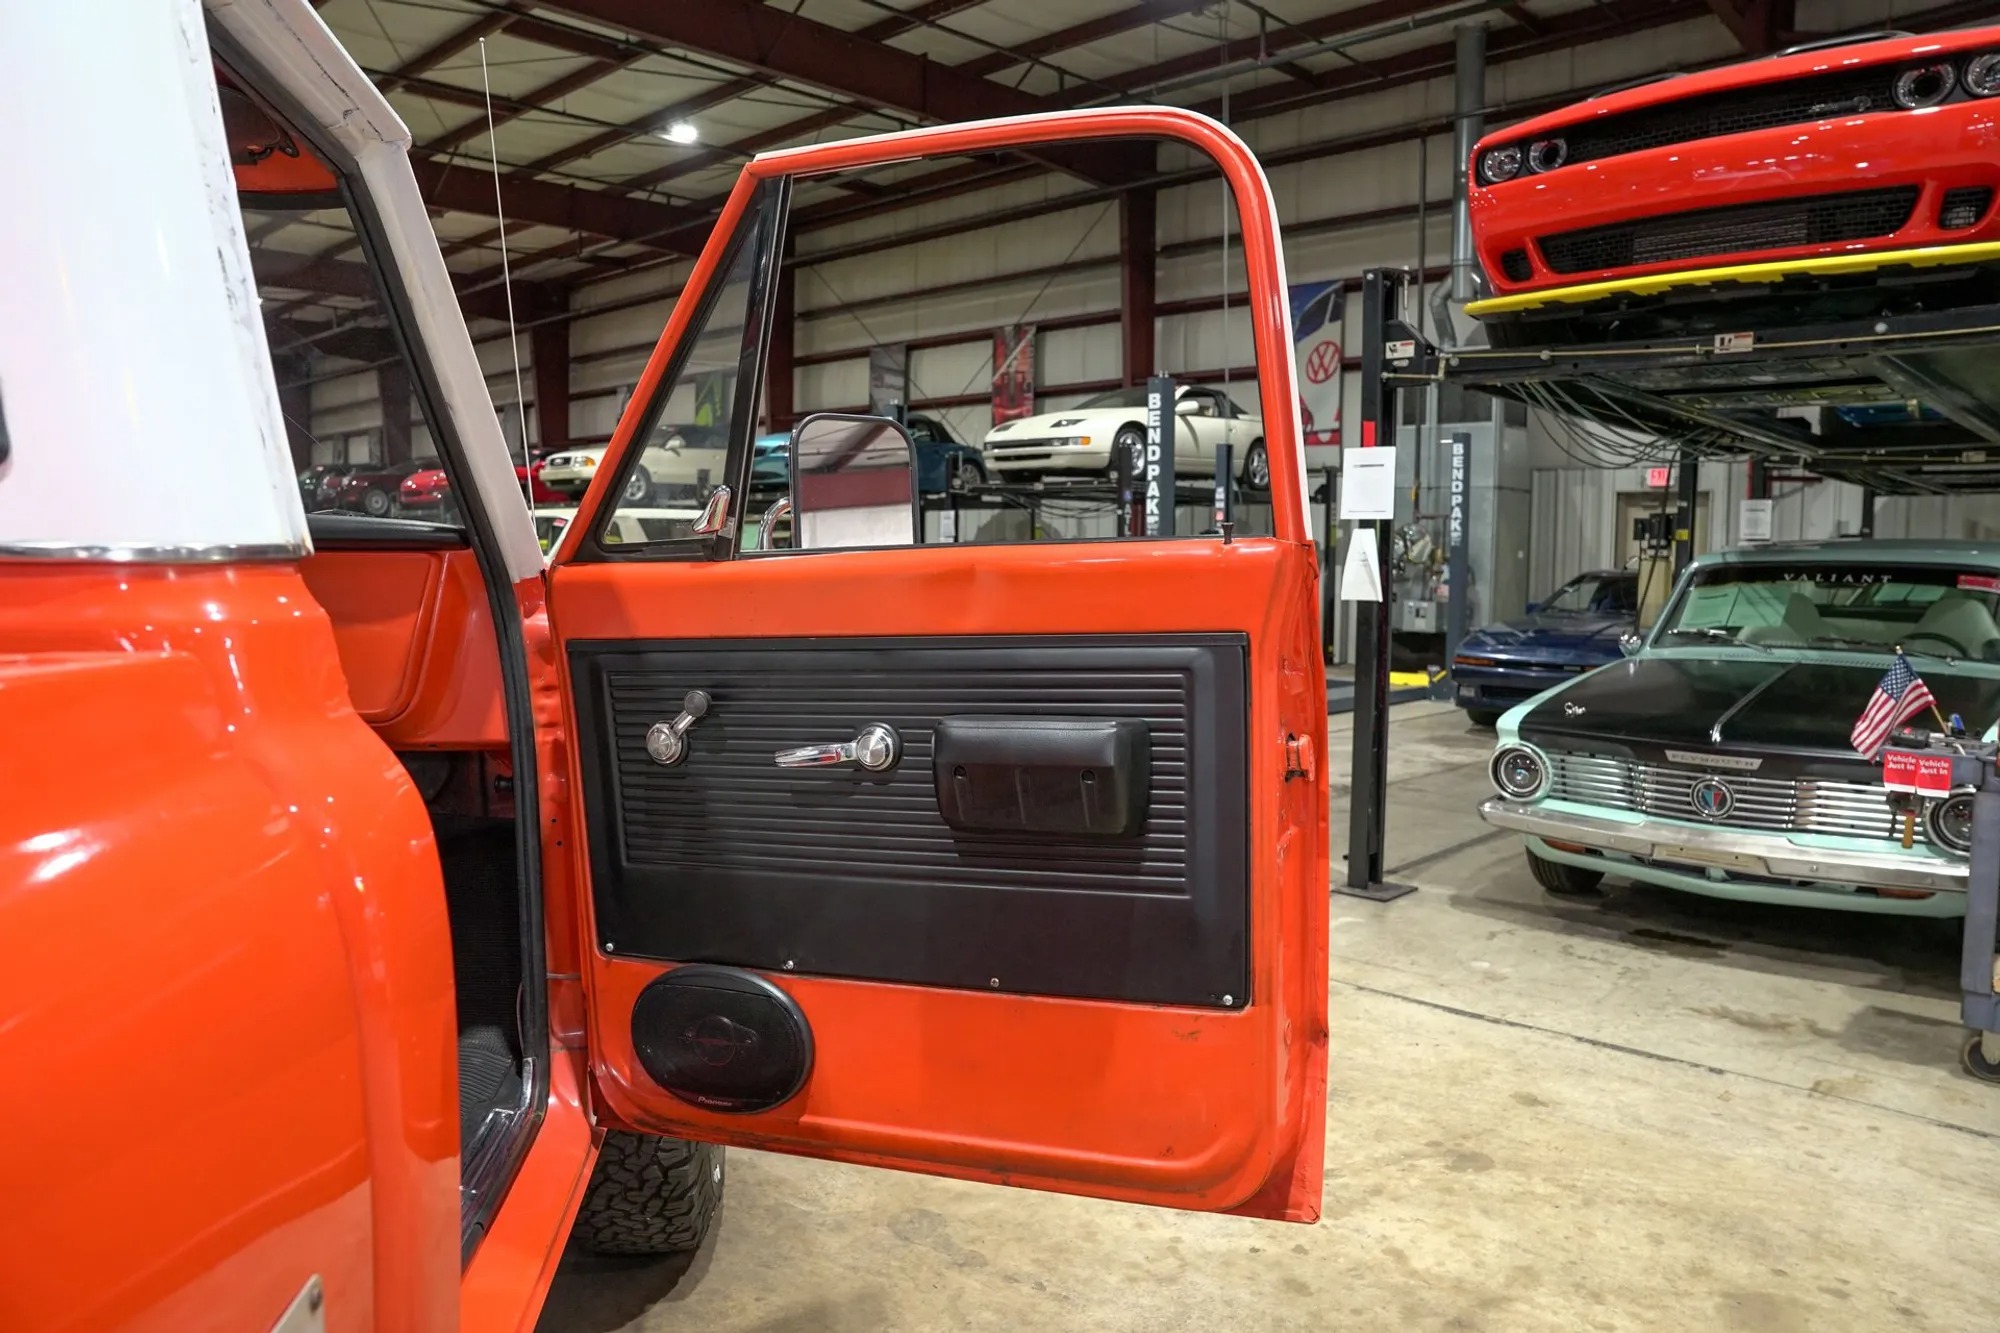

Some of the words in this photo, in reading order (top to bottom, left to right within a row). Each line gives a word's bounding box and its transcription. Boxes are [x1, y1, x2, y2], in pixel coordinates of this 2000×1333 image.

[1146, 393, 1161, 515] BENDPAK
[1450, 443, 1464, 531] BENDPAK
[1784, 573, 1892, 583] VALIANT
[1887, 754, 1917, 764] Vehicle
[1887, 762, 1905, 770] Just
[1918, 760, 1950, 769] Vehicle
[1920, 767, 1938, 775] Just
